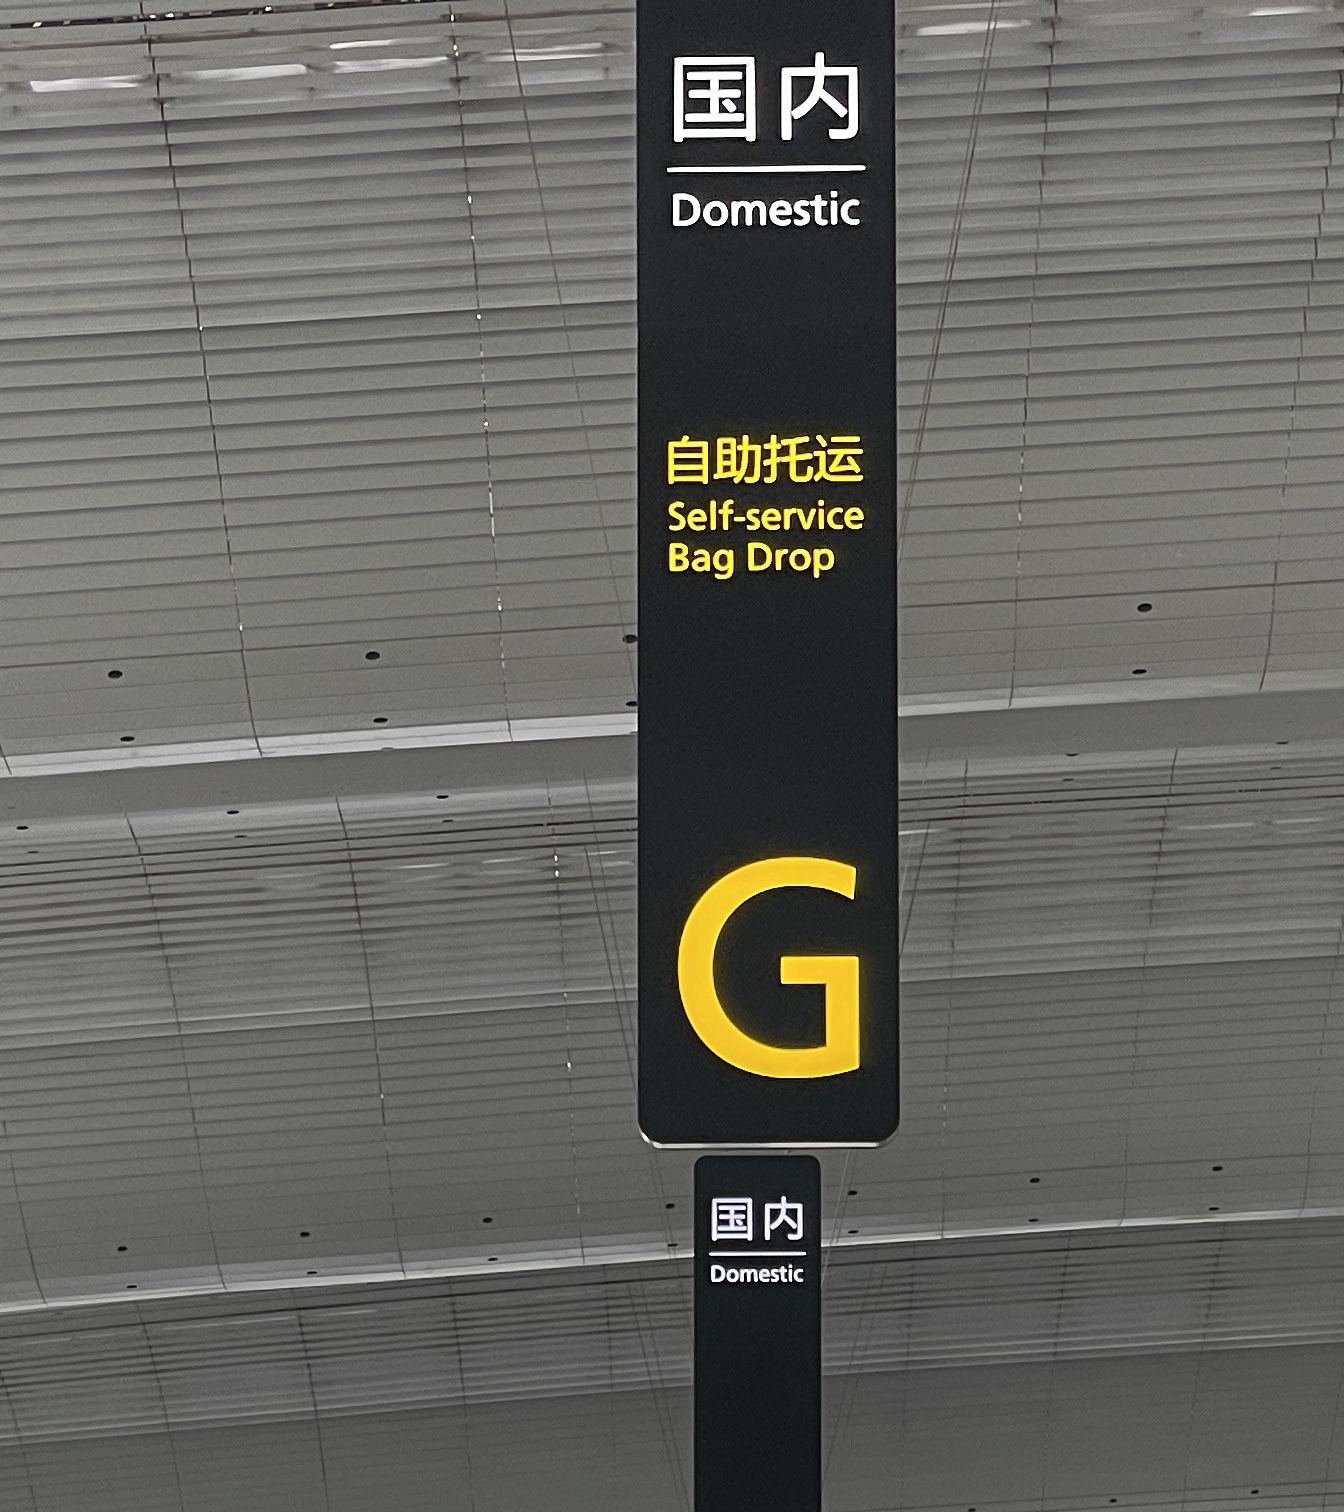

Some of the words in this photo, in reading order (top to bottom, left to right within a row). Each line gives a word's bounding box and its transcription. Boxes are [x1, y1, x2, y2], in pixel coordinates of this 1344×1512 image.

[673, 51, 859, 143] 国内
[672, 190, 861, 227] Domestic
[667, 434, 864, 485] 自助托运
[668, 498, 865, 532] Self-service
[668, 542, 735, 580] Bag
[747, 541, 835, 579] Drop
[677, 856, 861, 1079] G
[711, 1196, 804, 1241] 国内
[710, 1264, 804, 1283] Domestic
